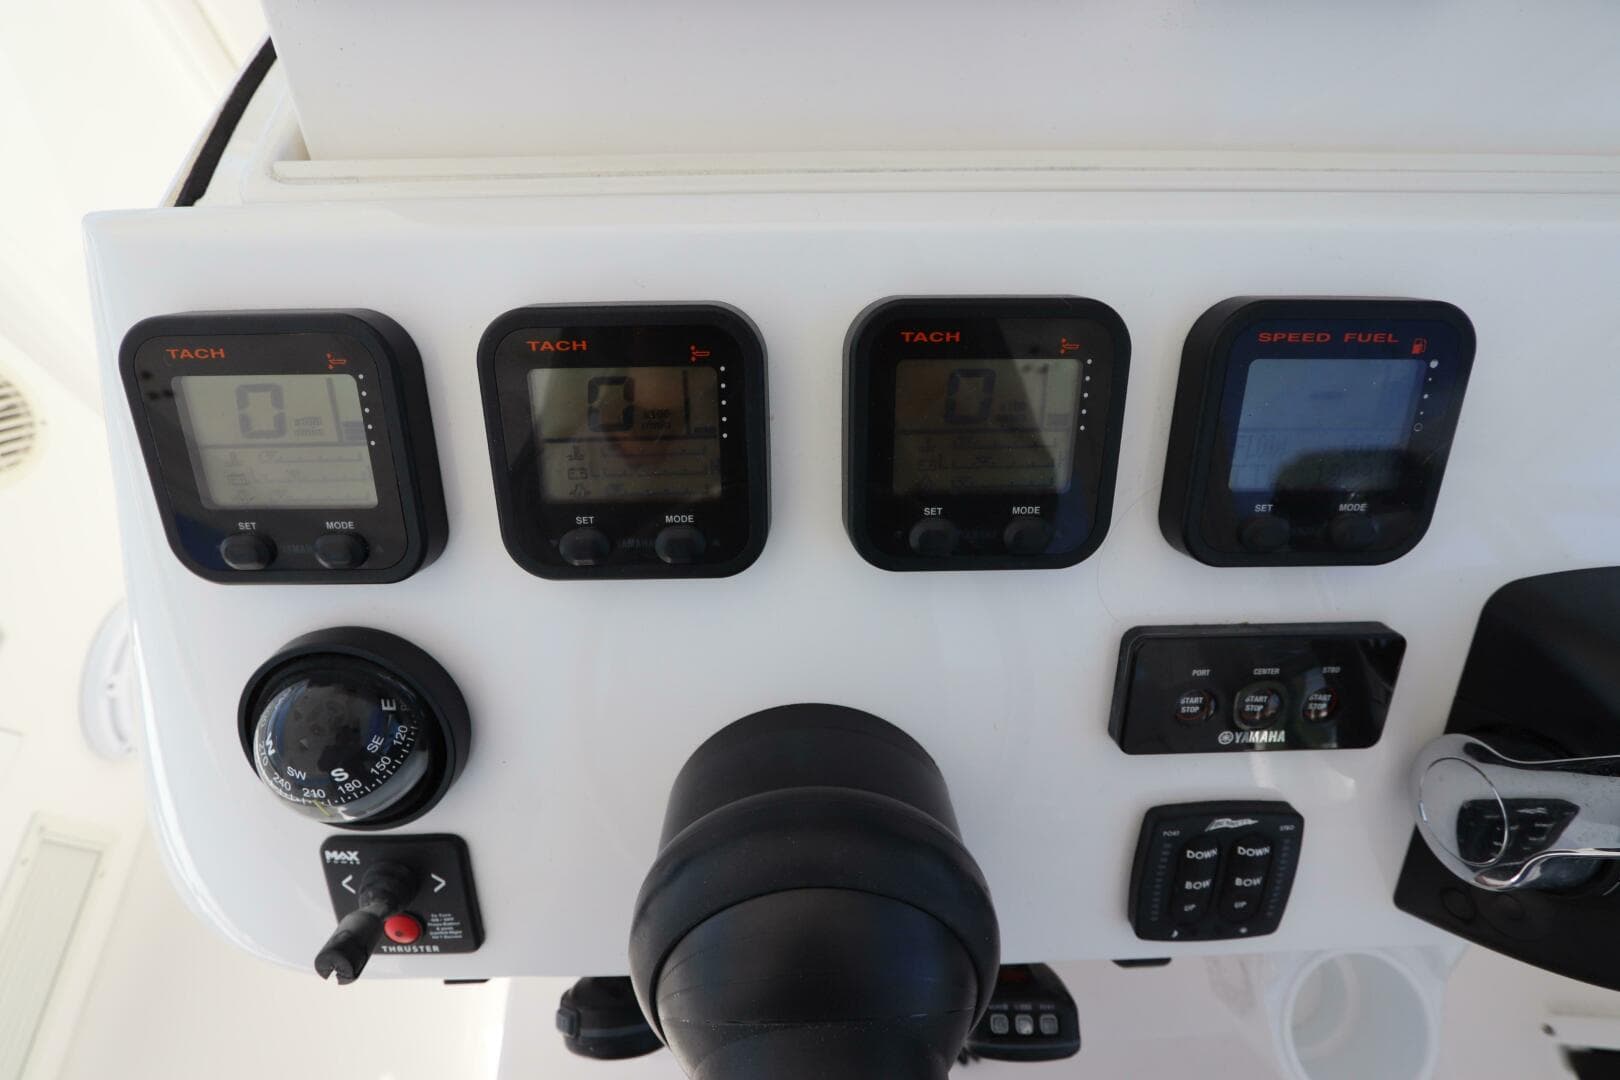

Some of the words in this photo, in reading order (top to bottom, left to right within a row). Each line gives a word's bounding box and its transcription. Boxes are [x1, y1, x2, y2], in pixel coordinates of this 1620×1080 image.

[901, 331, 961, 343] TACH
[1257, 332, 1332, 343] SPEED
[1343, 332, 1401, 343] FUEL
[526, 340, 588, 352] TACH
[166, 348, 225, 360] TACH
[588, 376, 635, 432] 0
[235, 383, 287, 439] 0
[923, 507, 943, 516] SET
[1012, 506, 1041, 515] MODE
[1254, 503, 1274, 513] SET
[1338, 503, 1368, 512] MODE
[575, 516, 595, 525] SET
[665, 514, 695, 523] MODE
[238, 521, 257, 531] SET
[325, 521, 355, 530] MODE
[1192, 669, 1211, 677] PORT
[1253, 667, 1280, 675] CENTER
[381, 698, 397, 711] E
[1180, 696, 1204, 705] START
[1245, 704, 1264, 712] STOP
[1308, 702, 1328, 711] STOP
[393, 724, 409, 746] 120
[1235, 730, 1286, 743] YAMAHA
[366, 734, 385, 753] SE
[370, 756, 392, 776] 150
[286, 766, 307, 780] SW
[330, 767, 349, 782] S
[272, 772, 292, 791] 240
[337, 779, 363, 794] 180
[302, 787, 326, 799] 210
[324, 850, 360, 861] MAX
[1186, 848, 1218, 860] DOWN
[1237, 846, 1271, 857] DOWN
[1185, 879, 1212, 890] BOW
[1234, 876, 1263, 887] BOW
[1184, 904, 1197, 912] UP
[1234, 901, 1247, 909] UP
[381, 945, 440, 953] THRUSTER
